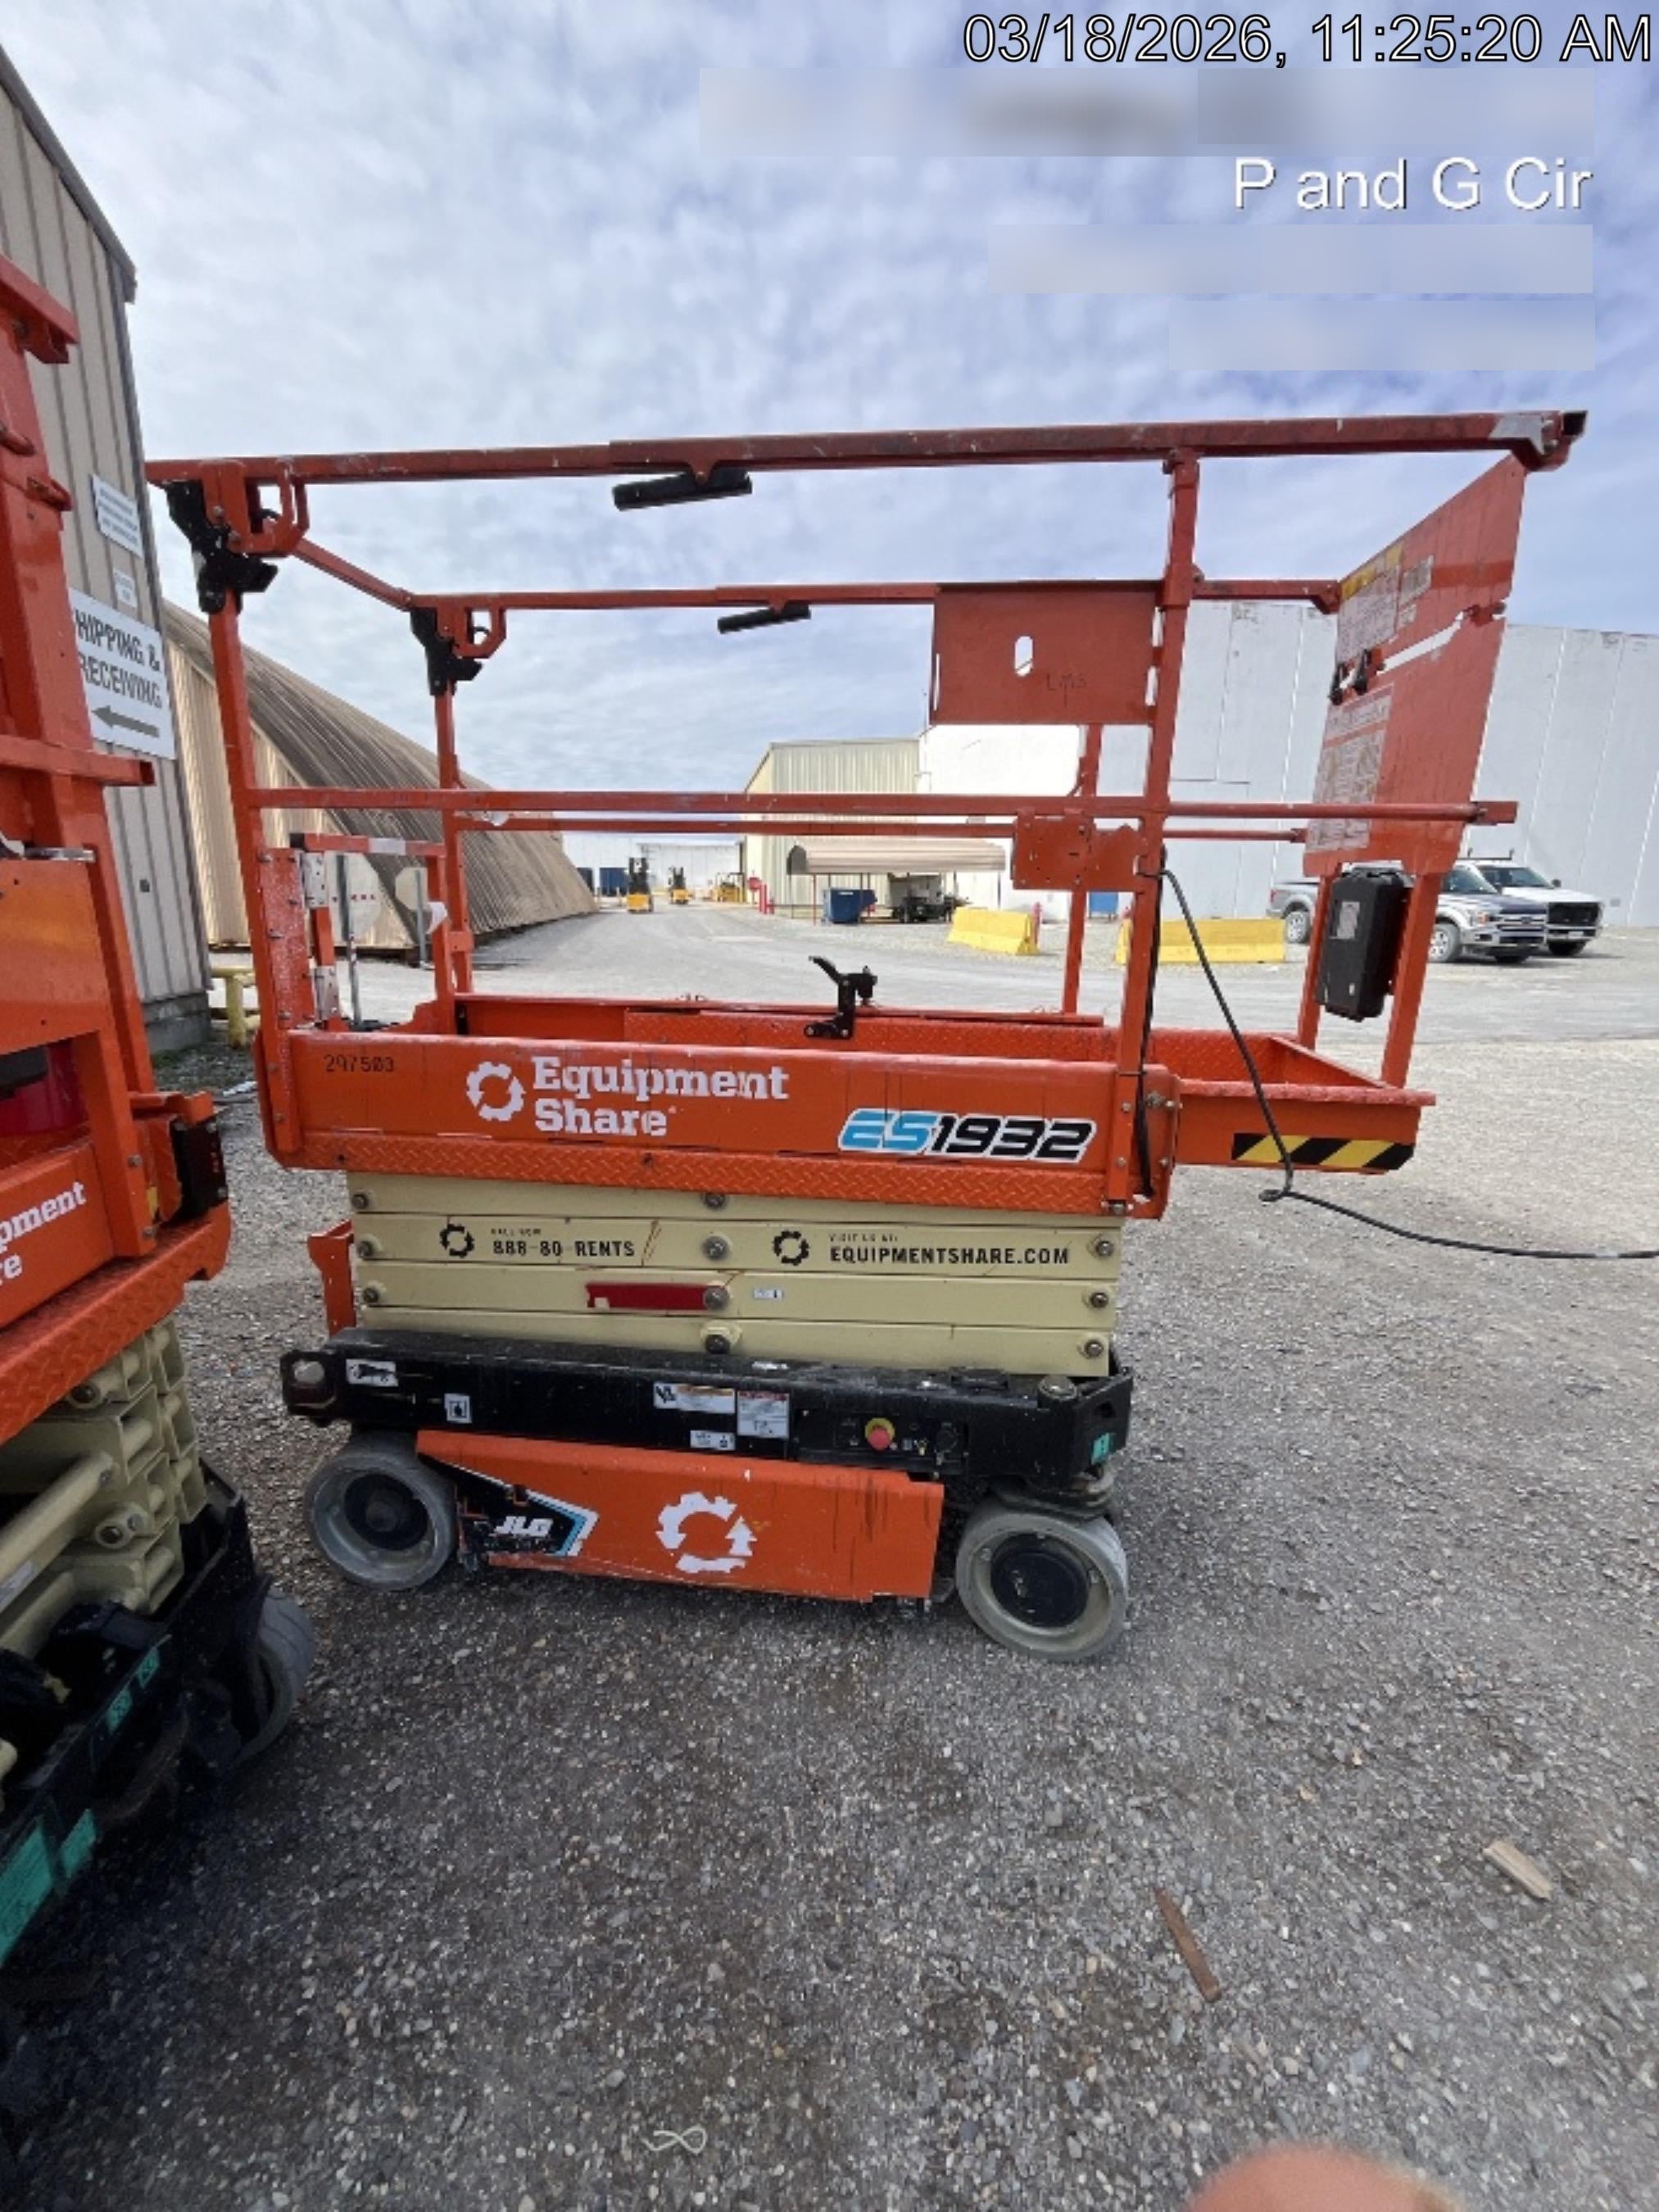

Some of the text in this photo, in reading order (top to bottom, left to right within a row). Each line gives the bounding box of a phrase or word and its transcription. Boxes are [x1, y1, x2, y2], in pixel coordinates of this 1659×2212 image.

[75, 610, 161, 672] HIPPING &
[323, 1054, 394, 1073] 297503
[532, 1055, 789, 1102] Equipment
[534, 1098, 668, 1136] Share
[838, 1108, 1095, 1163] ES1932
[0, 1181, 87, 1254] pment
[829, 1246, 1069, 1266] EQUIPMENTSHARE.COM
[492, 1516, 555, 1539] JLG
